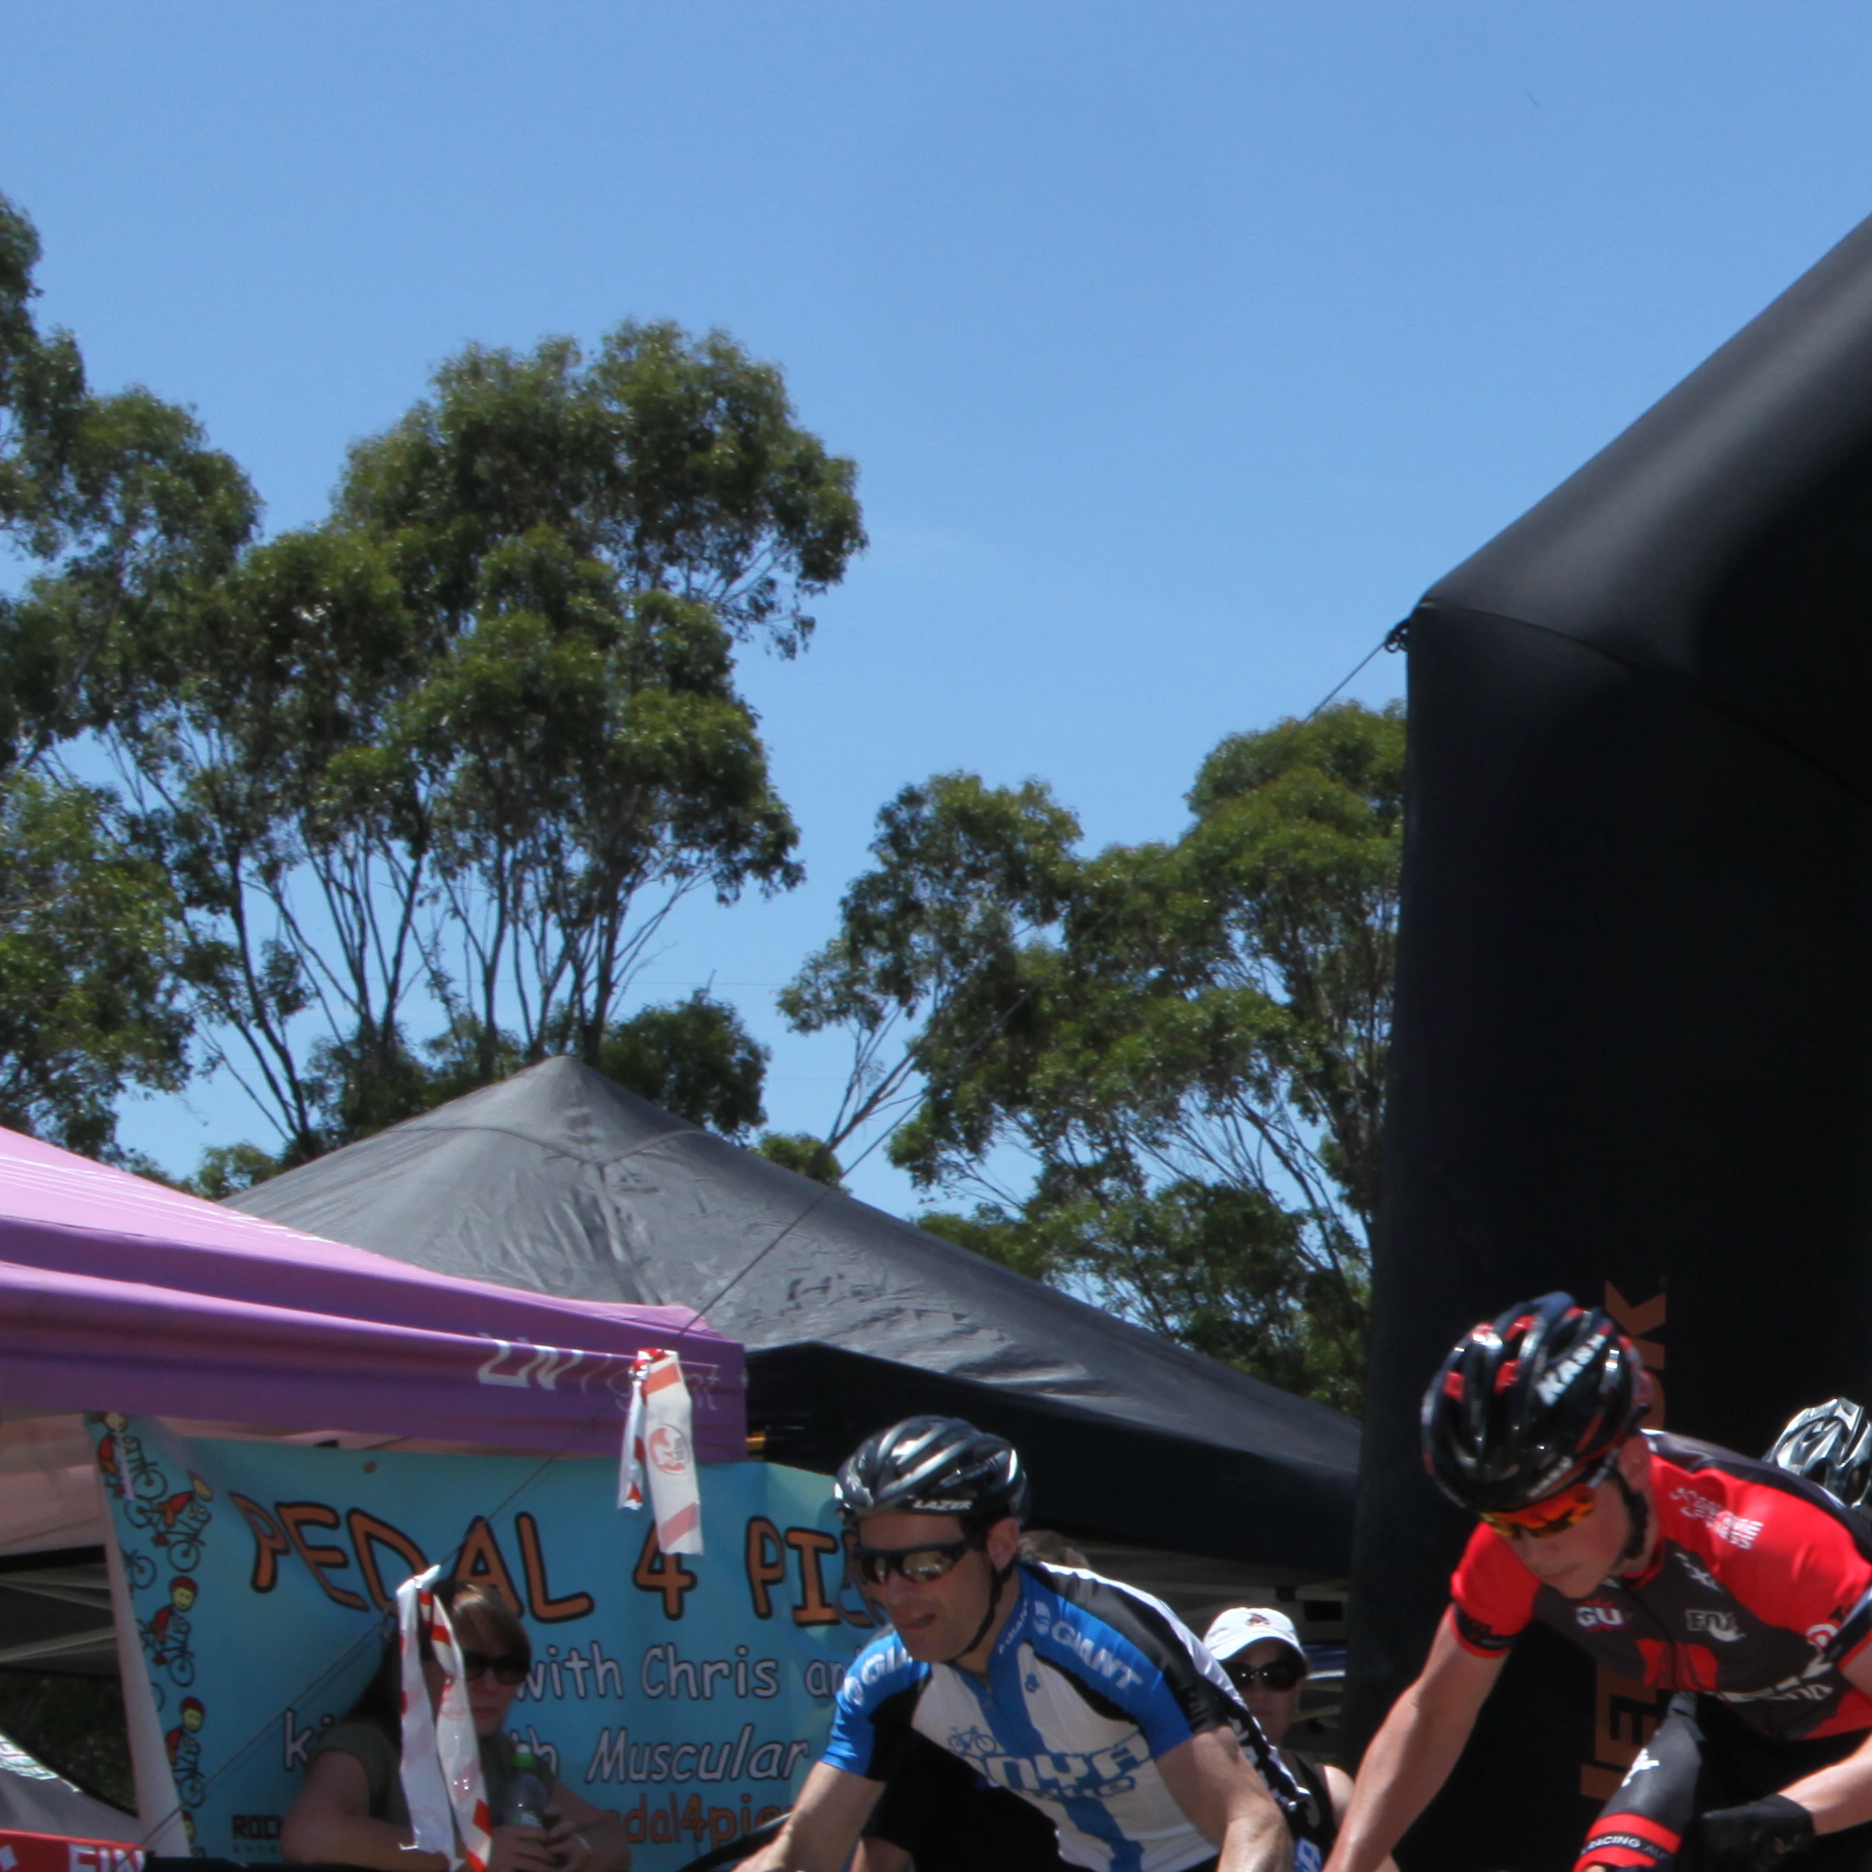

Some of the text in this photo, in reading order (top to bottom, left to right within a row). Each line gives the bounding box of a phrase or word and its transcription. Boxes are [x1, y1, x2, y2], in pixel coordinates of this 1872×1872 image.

[228, 1492, 594, 1625] PEDAL
[633, 1520, 697, 1620] 4
[1575, 1606, 1626, 1628] GU
[641, 1645, 778, 1701] Chris
[805, 1658, 850, 1698] an
[1051, 1620, 1143, 1690] GIANT
[585, 1725, 808, 1784] Muscular
[231, 1815, 284, 1840] ROC
